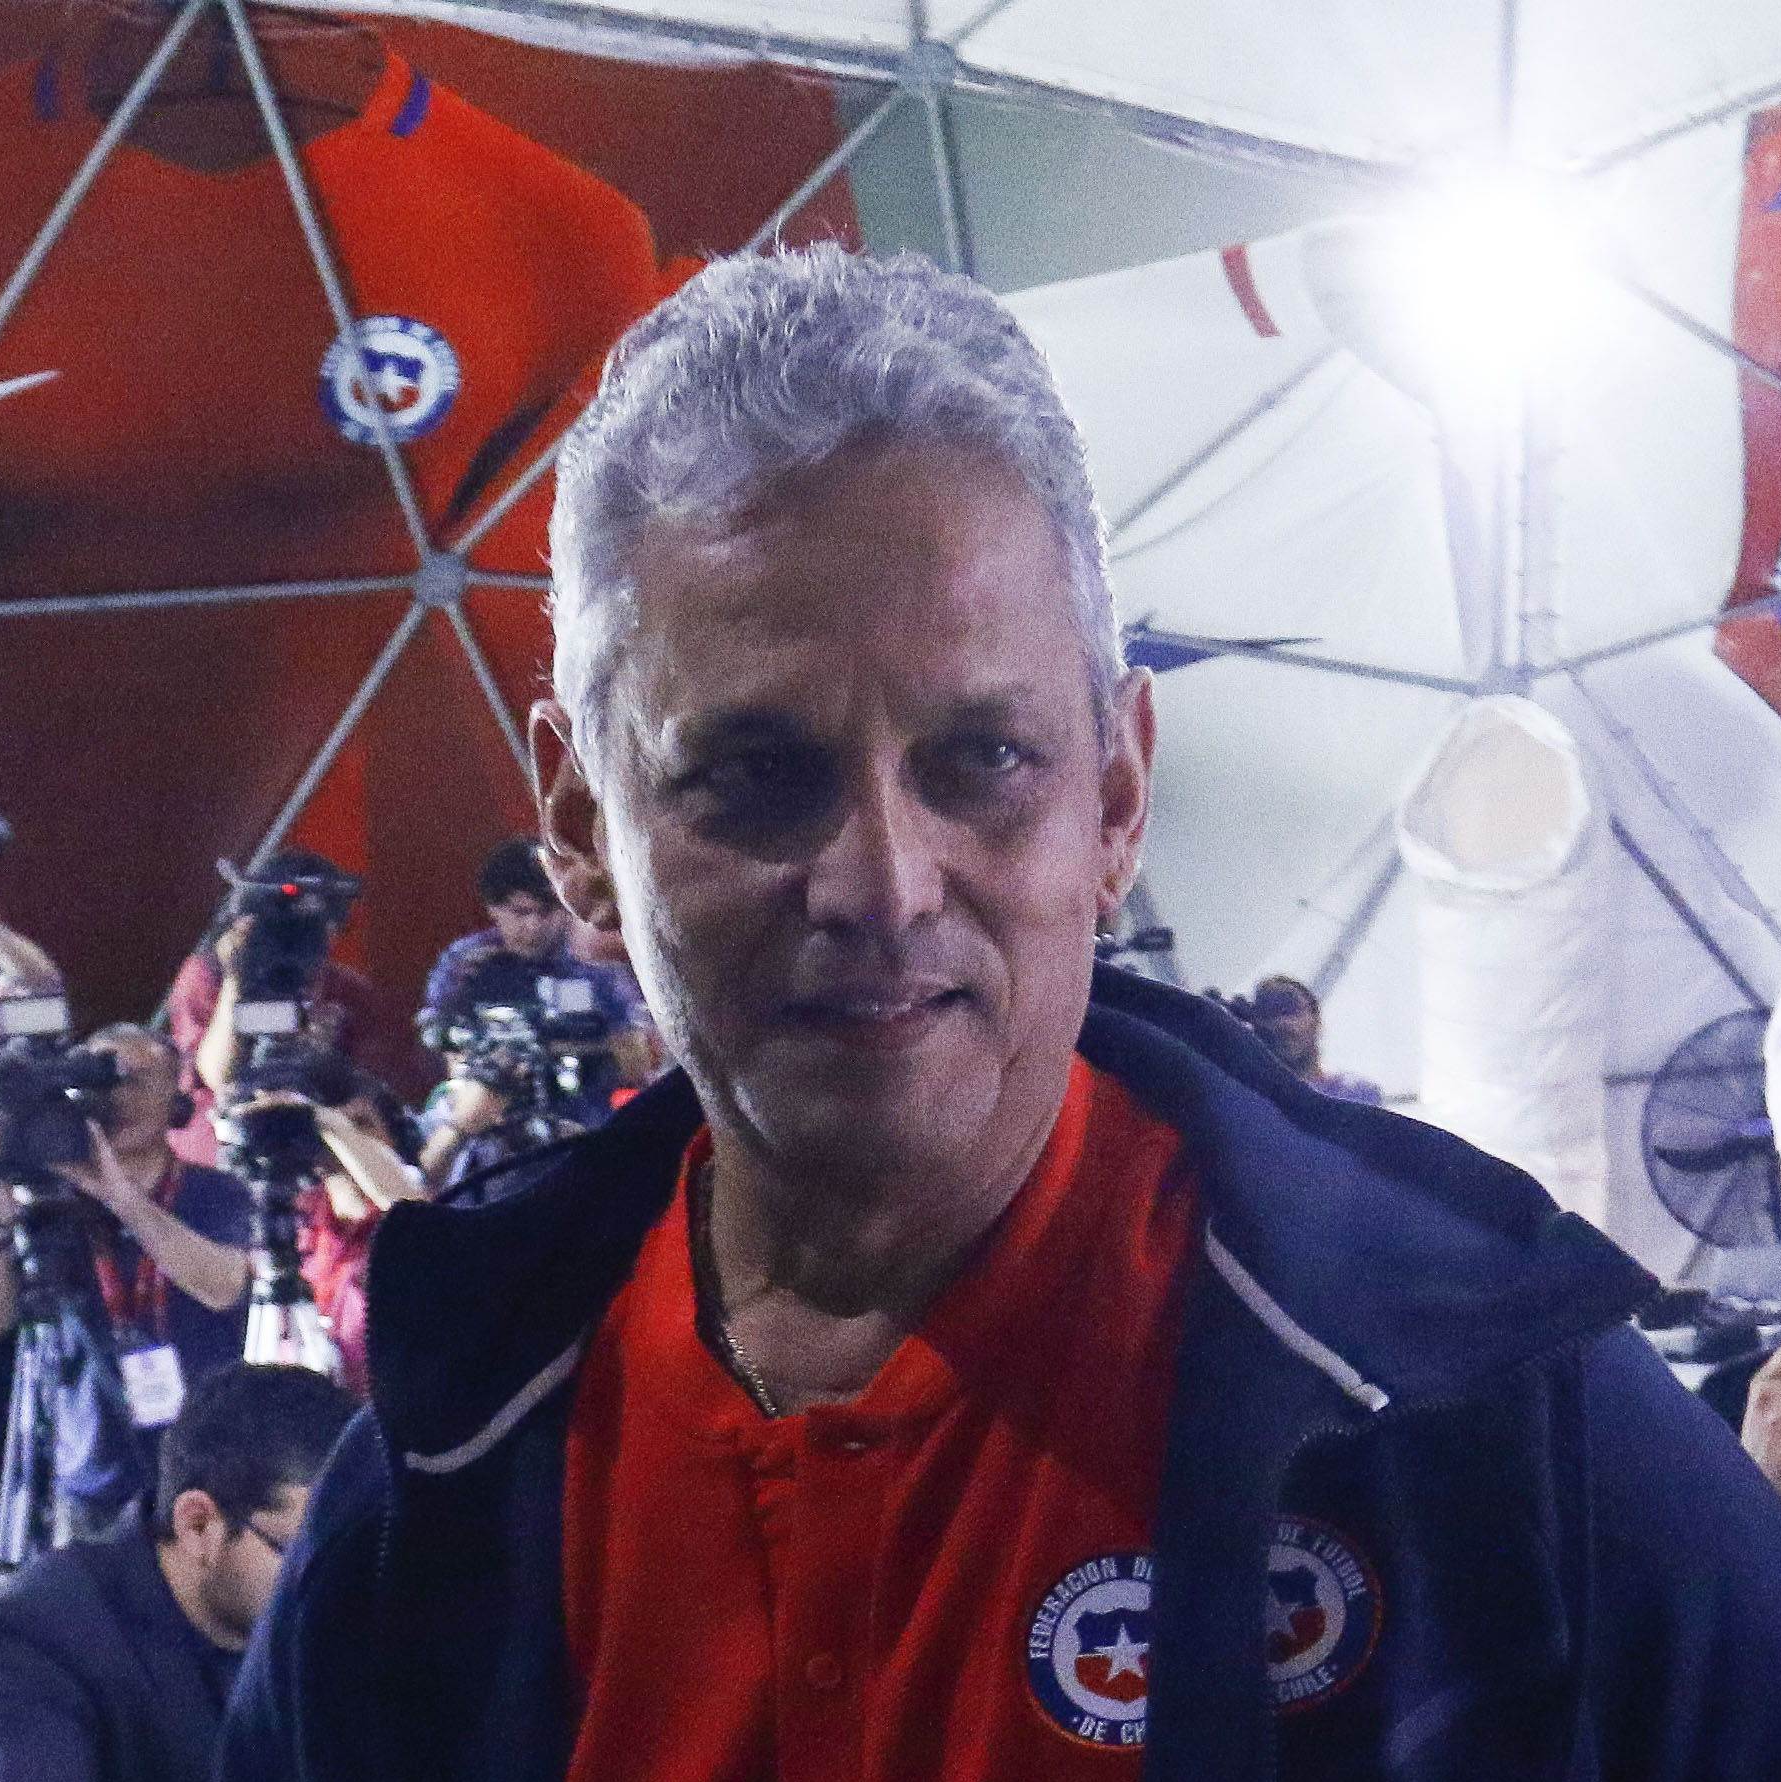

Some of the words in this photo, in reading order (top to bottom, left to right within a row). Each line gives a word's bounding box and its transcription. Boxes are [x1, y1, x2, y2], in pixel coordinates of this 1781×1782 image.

[1311, 1534, 1368, 1602] FUTBOL
[1027, 1556, 1118, 1661] FEDERACION
[1077, 1716, 1108, 1742] DE
